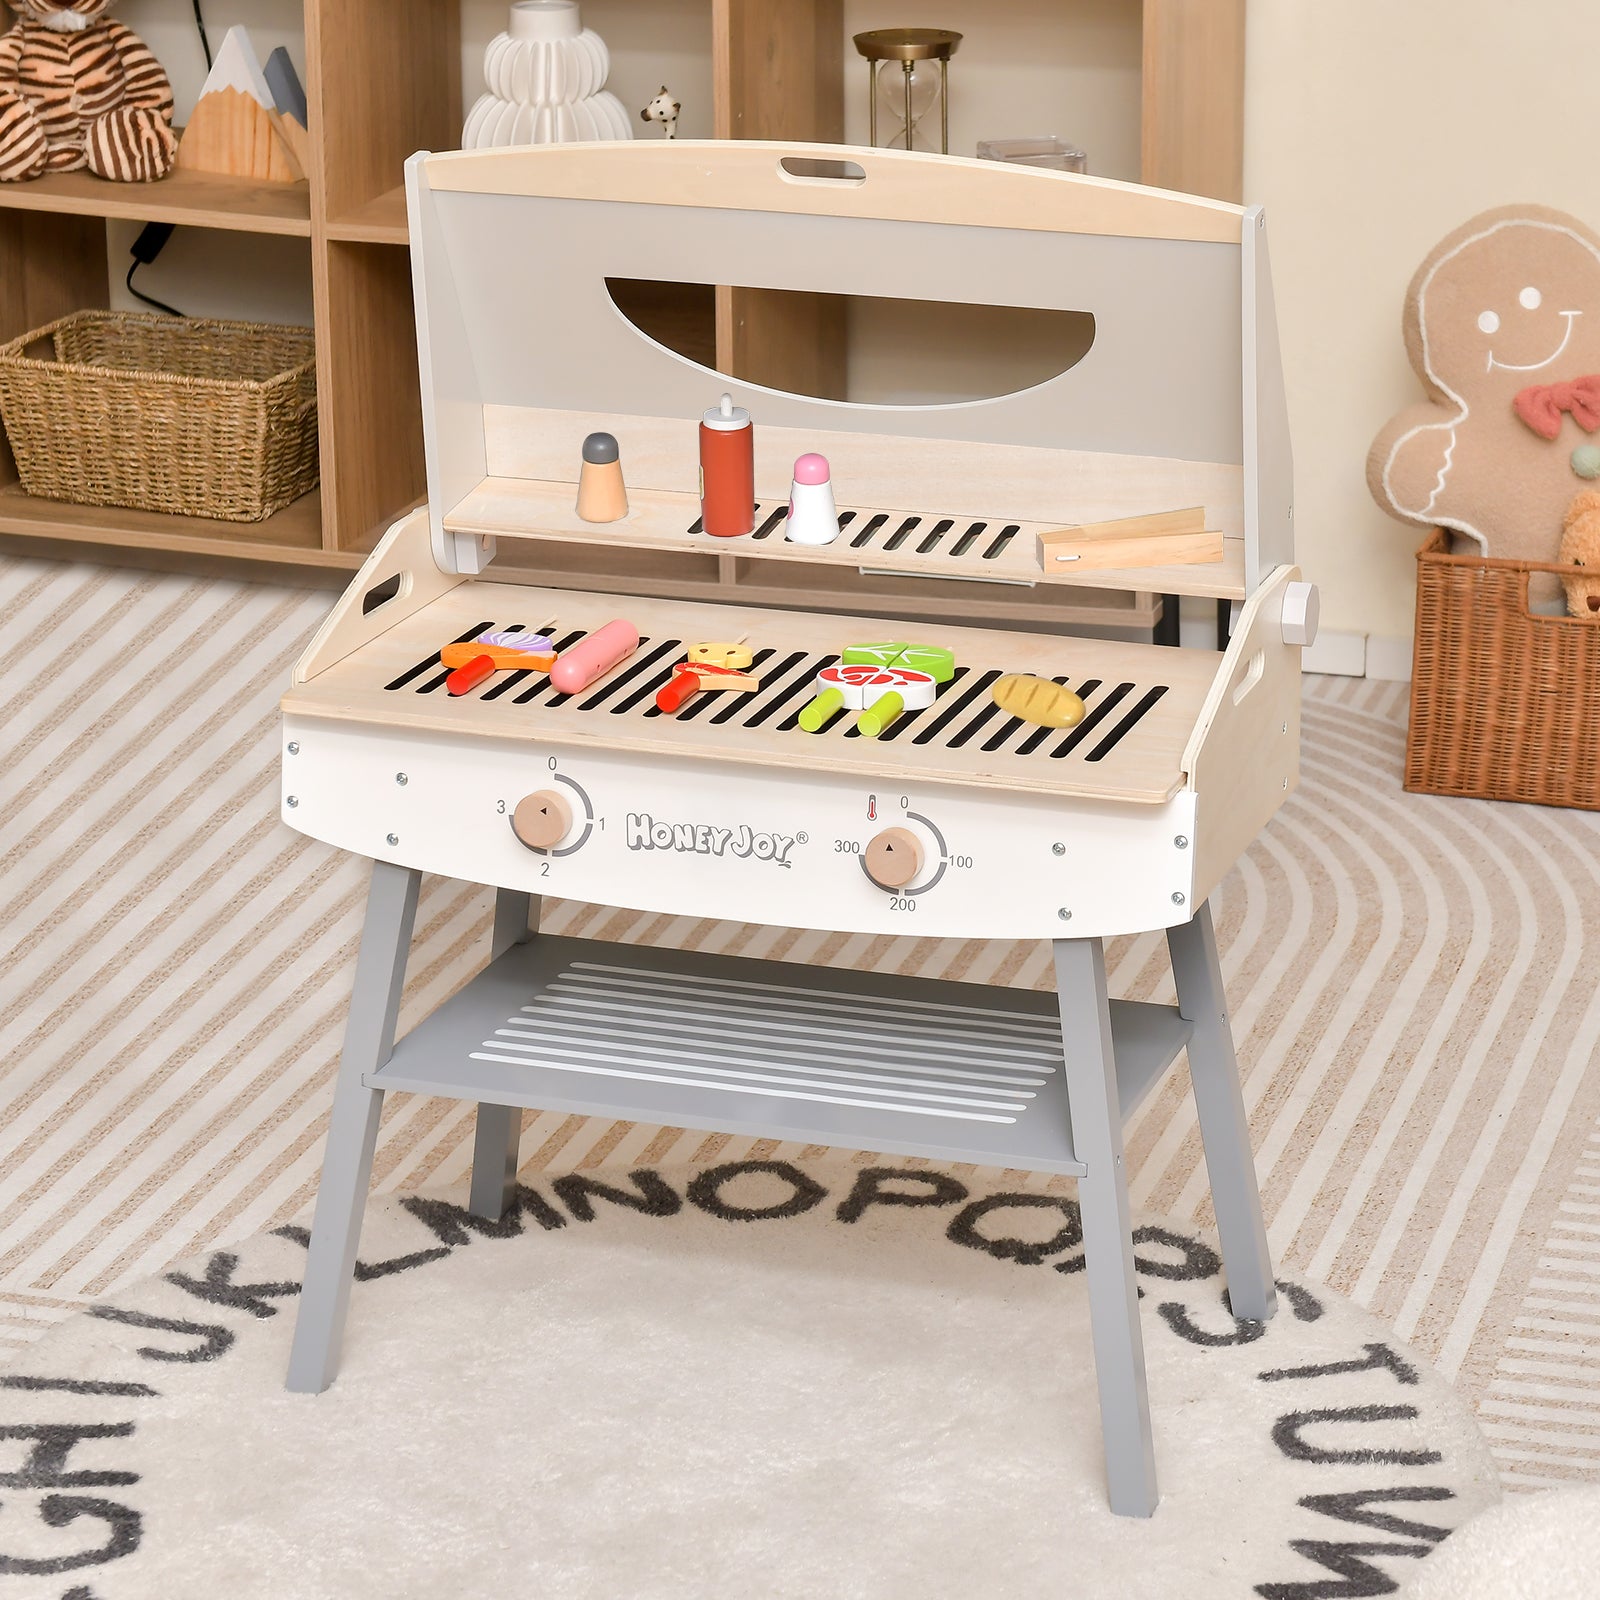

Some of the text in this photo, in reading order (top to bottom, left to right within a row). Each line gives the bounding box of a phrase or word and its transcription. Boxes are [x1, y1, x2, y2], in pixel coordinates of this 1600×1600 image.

[548, 756, 557, 771] 0
[496, 799, 506, 814] 3
[900, 795, 909, 809] 0
[599, 817, 605, 831] 1
[834, 839, 860, 854] 300
[949, 854, 973, 869] 100
[541, 862, 550, 877] 2
[889, 896, 916, 912] 200
